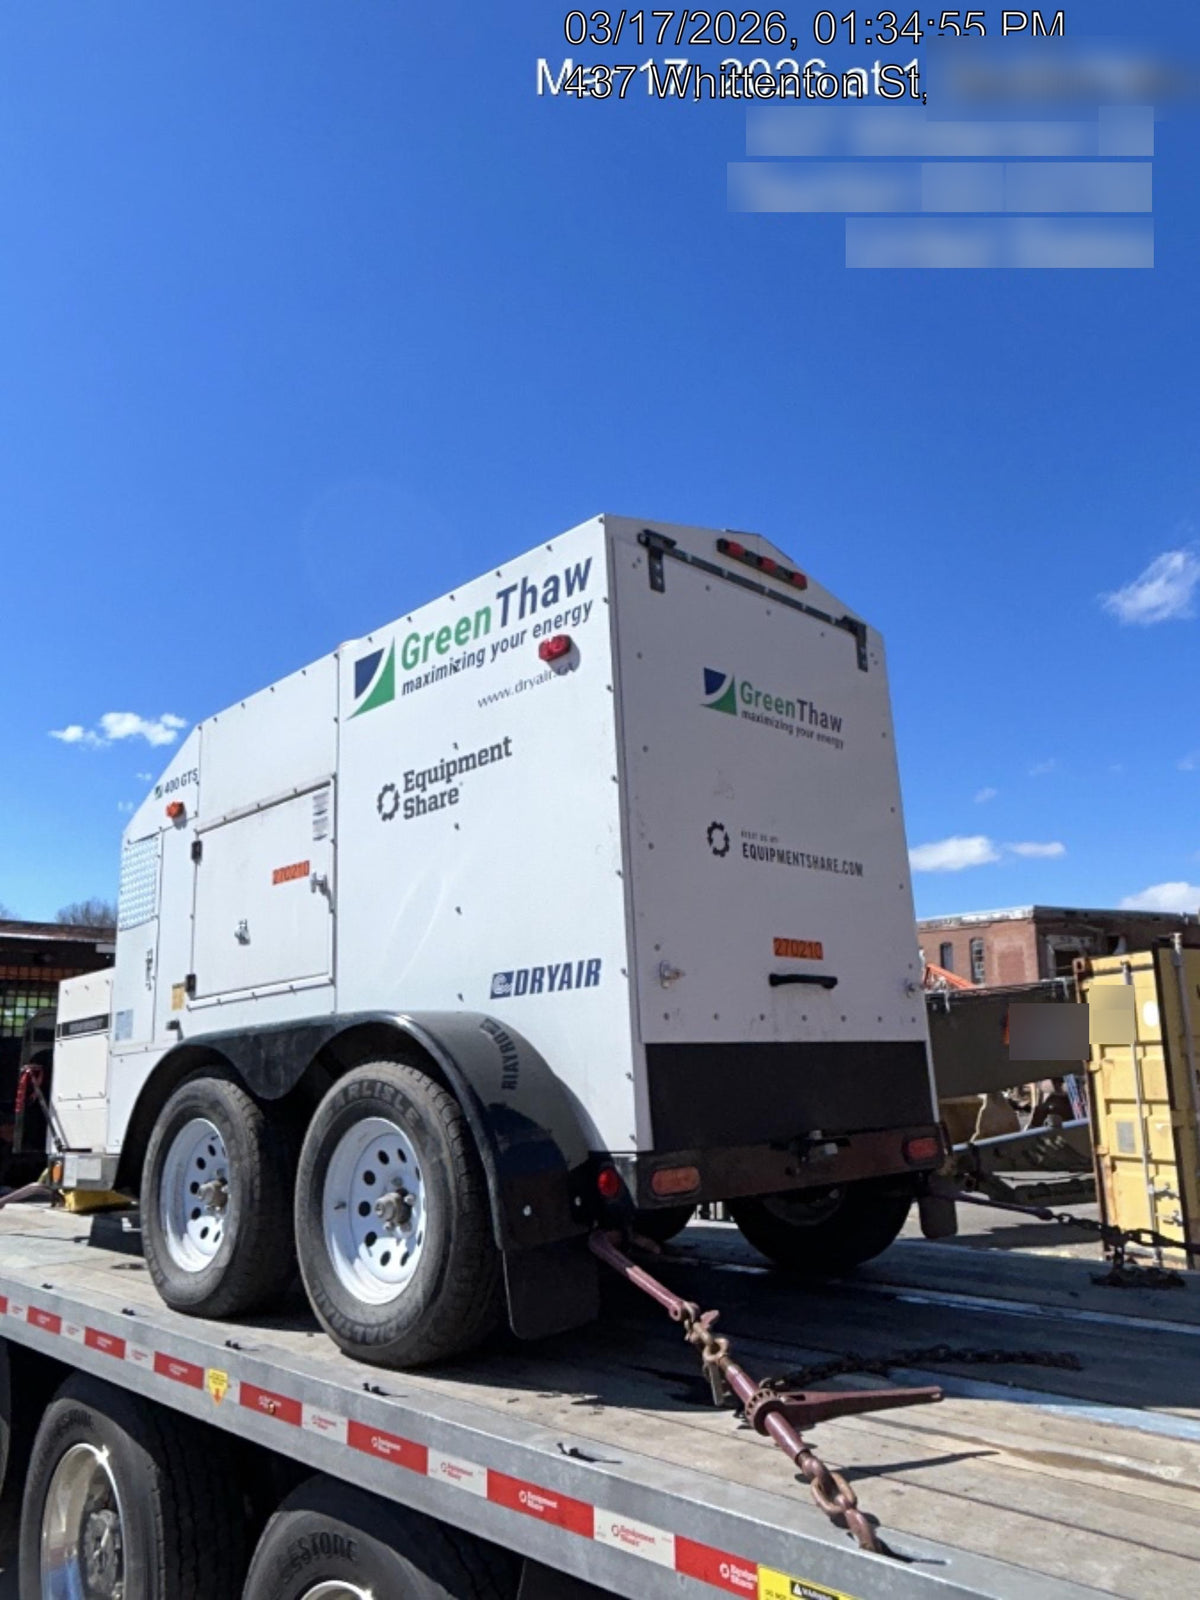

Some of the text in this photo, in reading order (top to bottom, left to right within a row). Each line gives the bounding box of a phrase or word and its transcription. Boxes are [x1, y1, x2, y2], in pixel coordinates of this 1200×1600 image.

[402, 600, 594, 696] maximizing your energy
[741, 710, 844, 750] maximizing your energy
[403, 736, 512, 793] Equipment
[403, 787, 460, 820] Share
[742, 842, 863, 877] EQUIPMENTSHARE.COM
[773, 937, 823, 960] 270210
[514, 958, 601, 996] DRYAIR
[494, 1030, 519, 1090] DRYAIR
